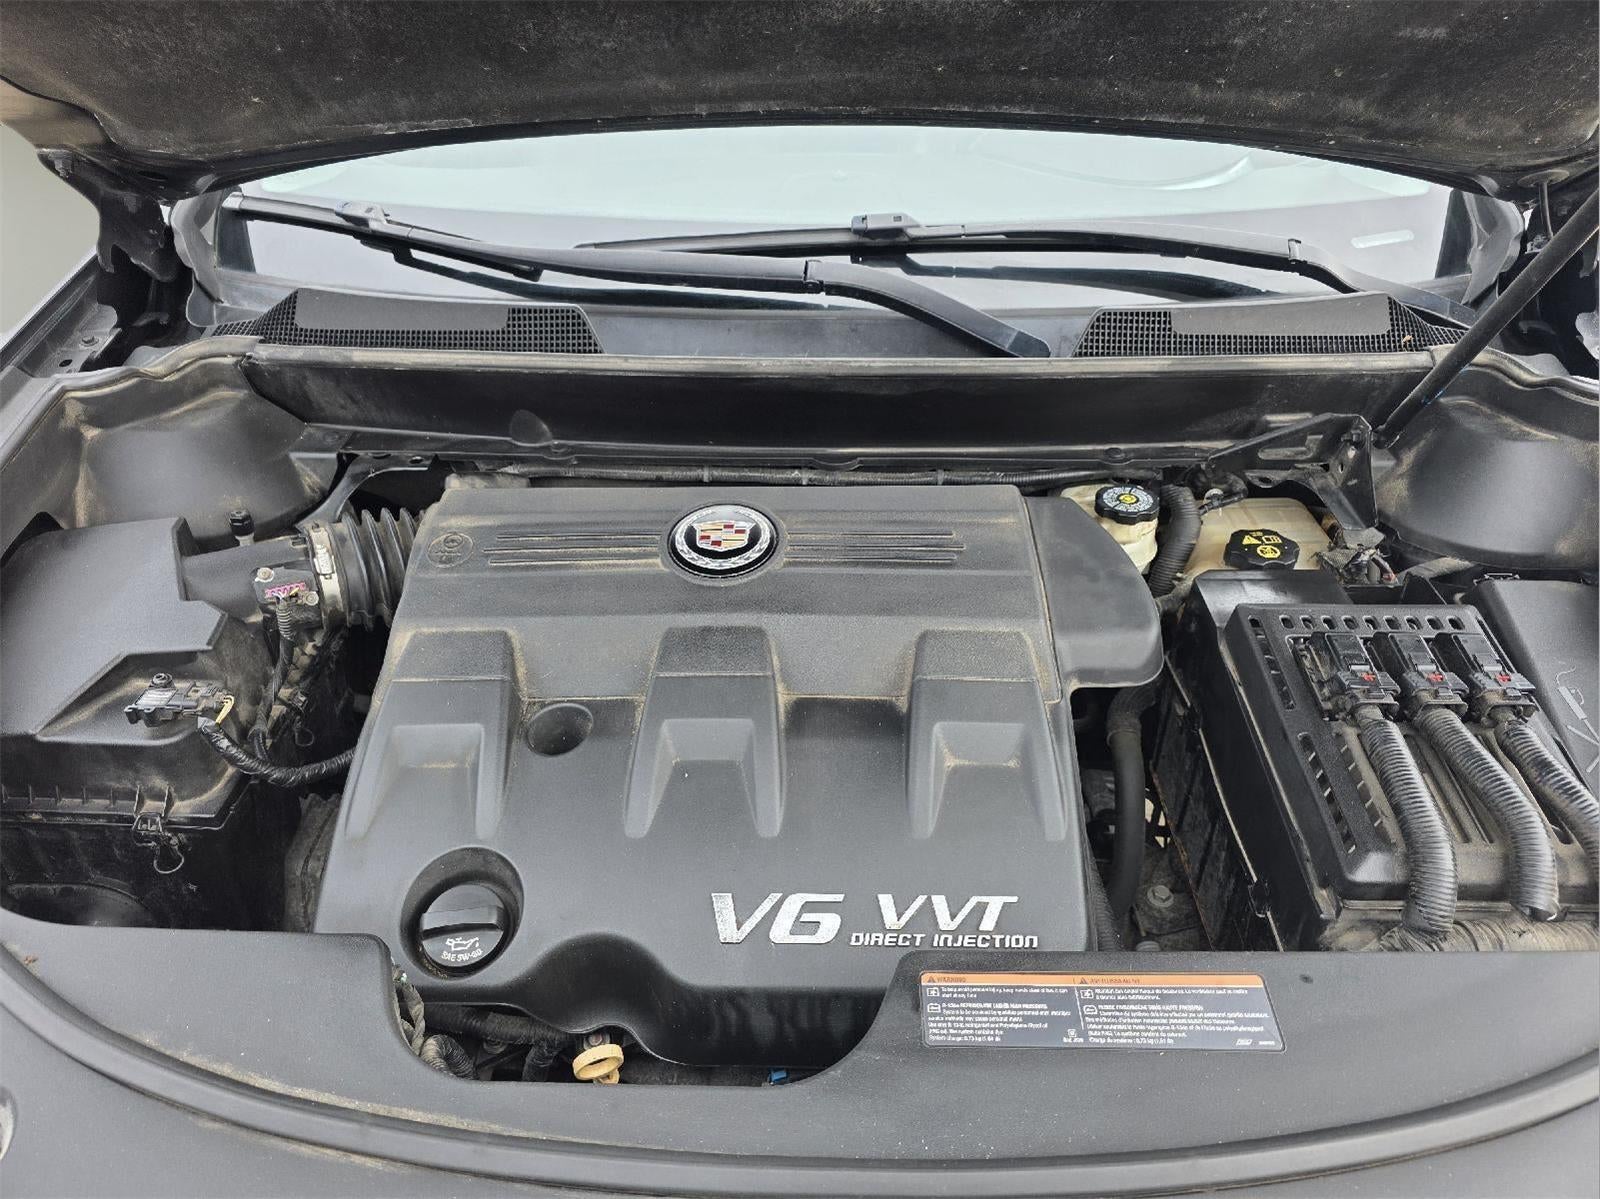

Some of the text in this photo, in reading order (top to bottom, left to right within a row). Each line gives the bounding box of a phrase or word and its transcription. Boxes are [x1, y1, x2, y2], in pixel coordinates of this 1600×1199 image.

[711, 892, 845, 944] V6
[876, 893, 1019, 931] VVT
[850, 932, 1038, 949] DIRECT INJECTION
